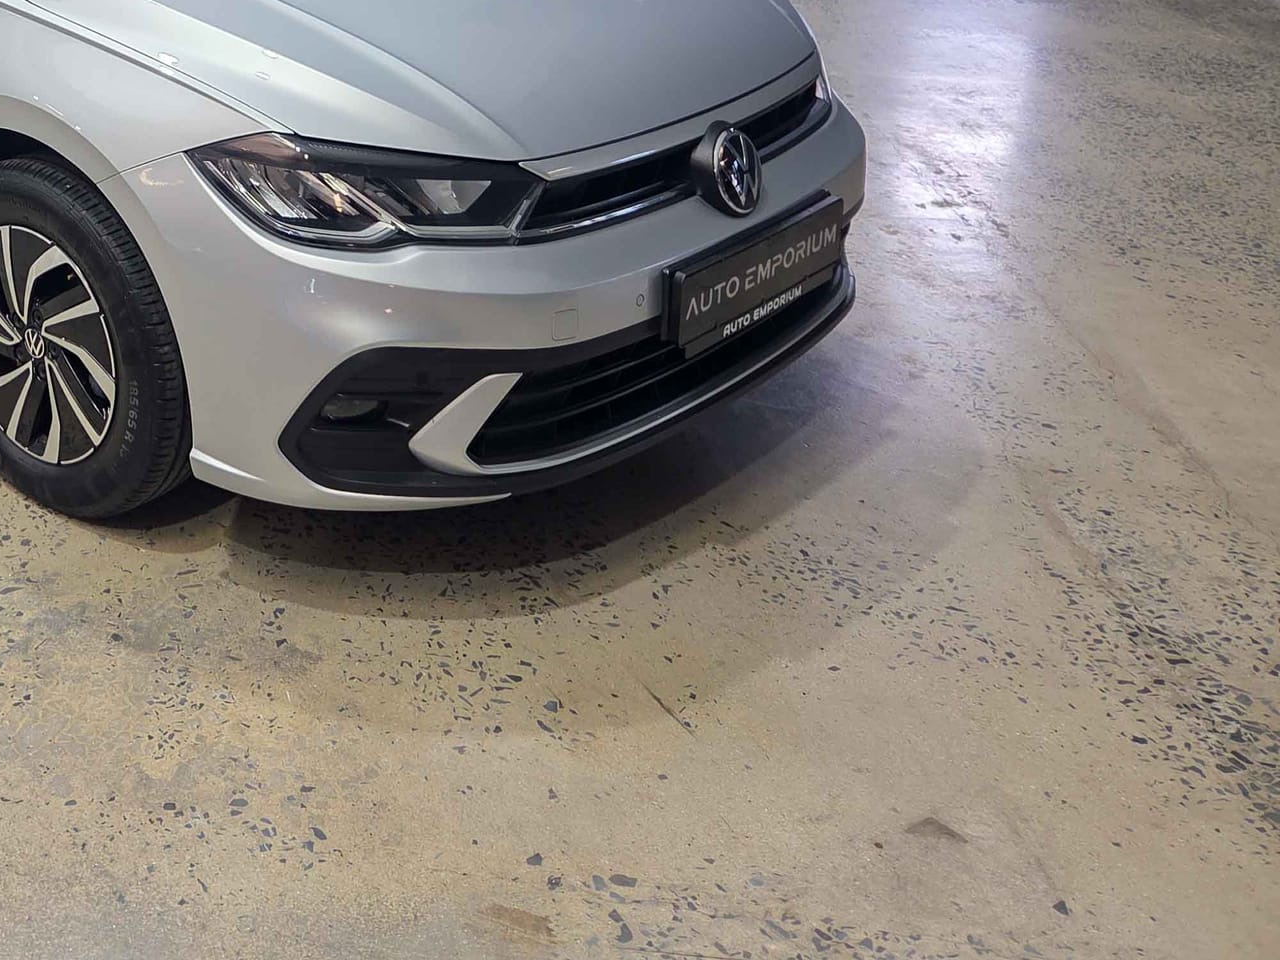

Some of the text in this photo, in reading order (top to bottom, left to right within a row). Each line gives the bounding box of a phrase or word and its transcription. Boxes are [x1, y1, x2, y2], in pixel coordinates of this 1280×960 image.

[686, 224, 837, 321] AUTO EMPORIUM
[753, 285, 802, 321] EMPORIUM
